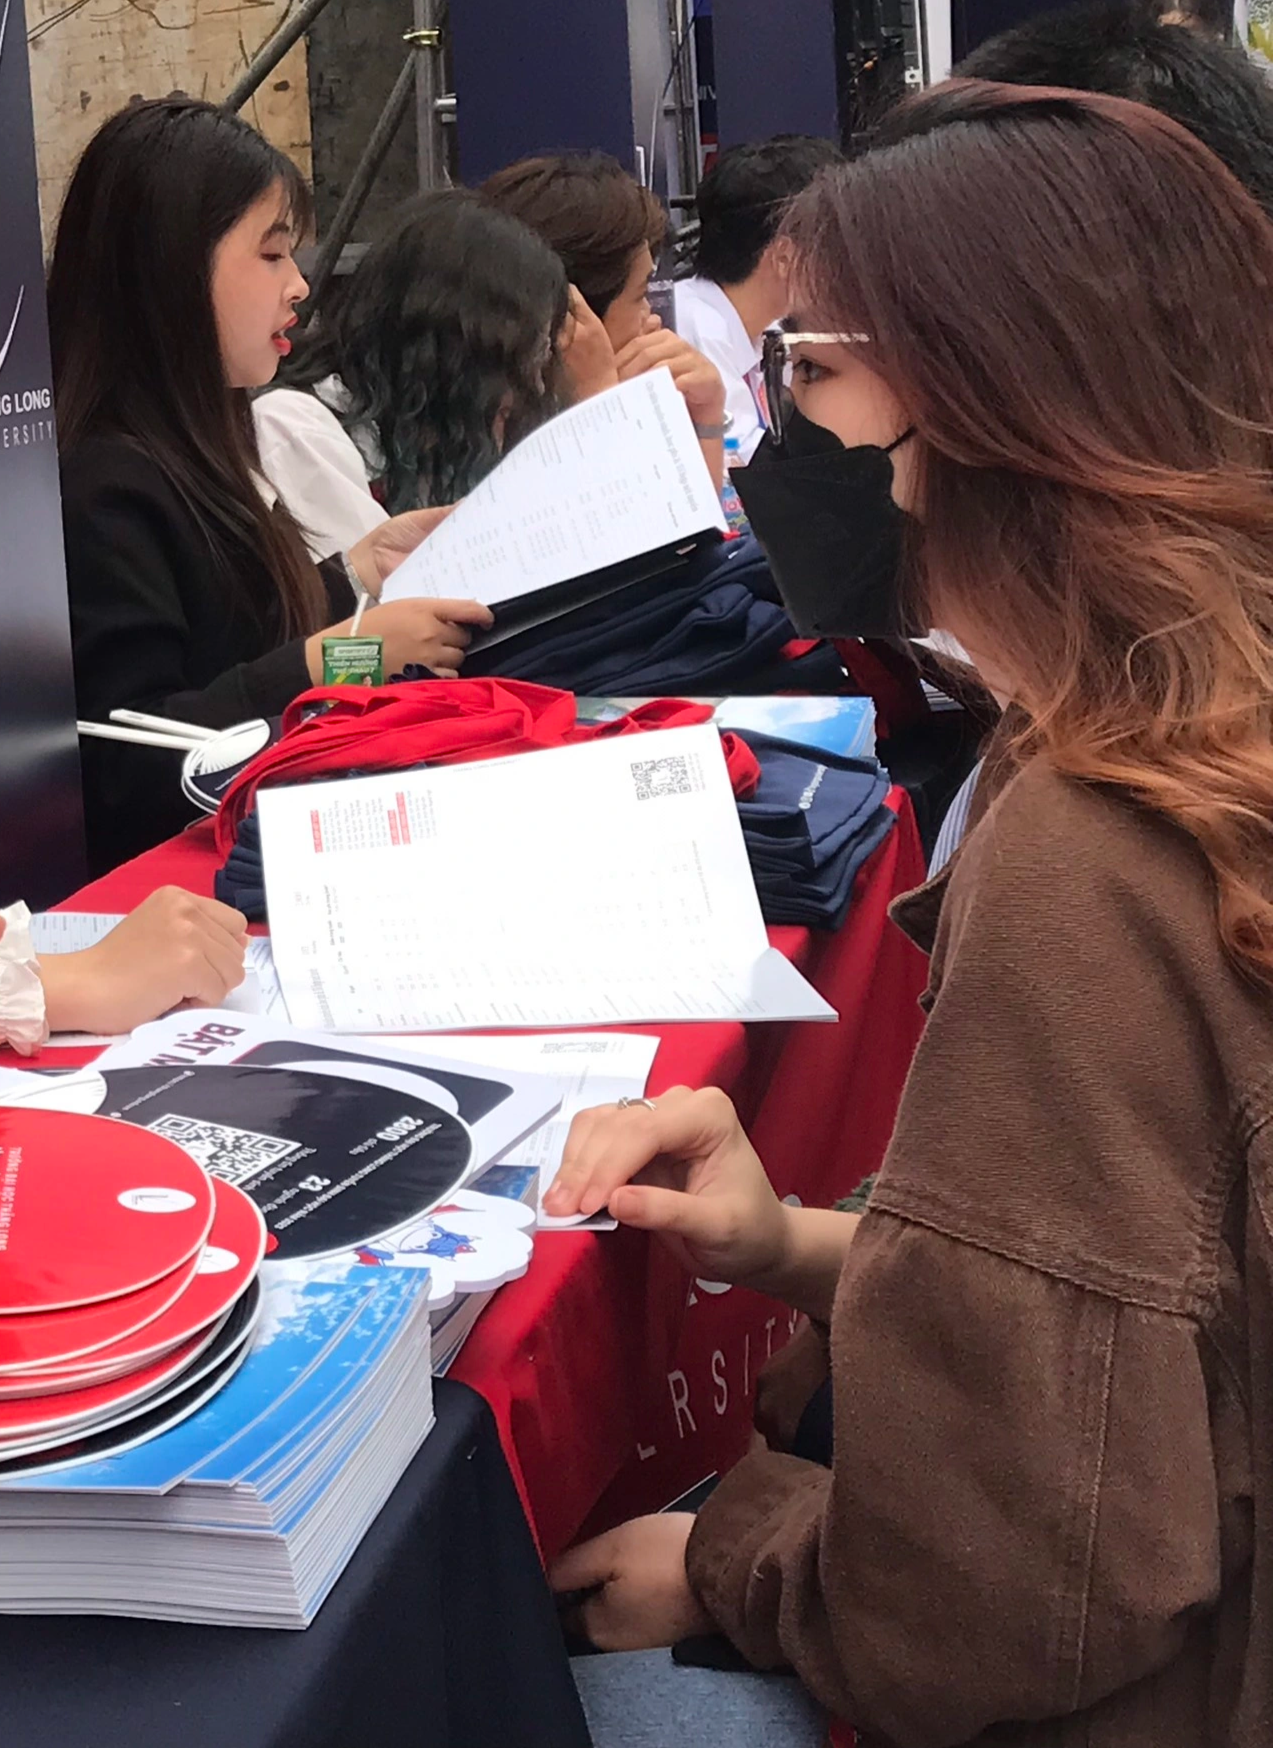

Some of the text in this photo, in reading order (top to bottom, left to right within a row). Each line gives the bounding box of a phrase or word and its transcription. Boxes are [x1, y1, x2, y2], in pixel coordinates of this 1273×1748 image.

[14, 388, 51, 413] LONG
[376, 1116, 423, 1142] 2800
[298, 1175, 332, 1192] 23
